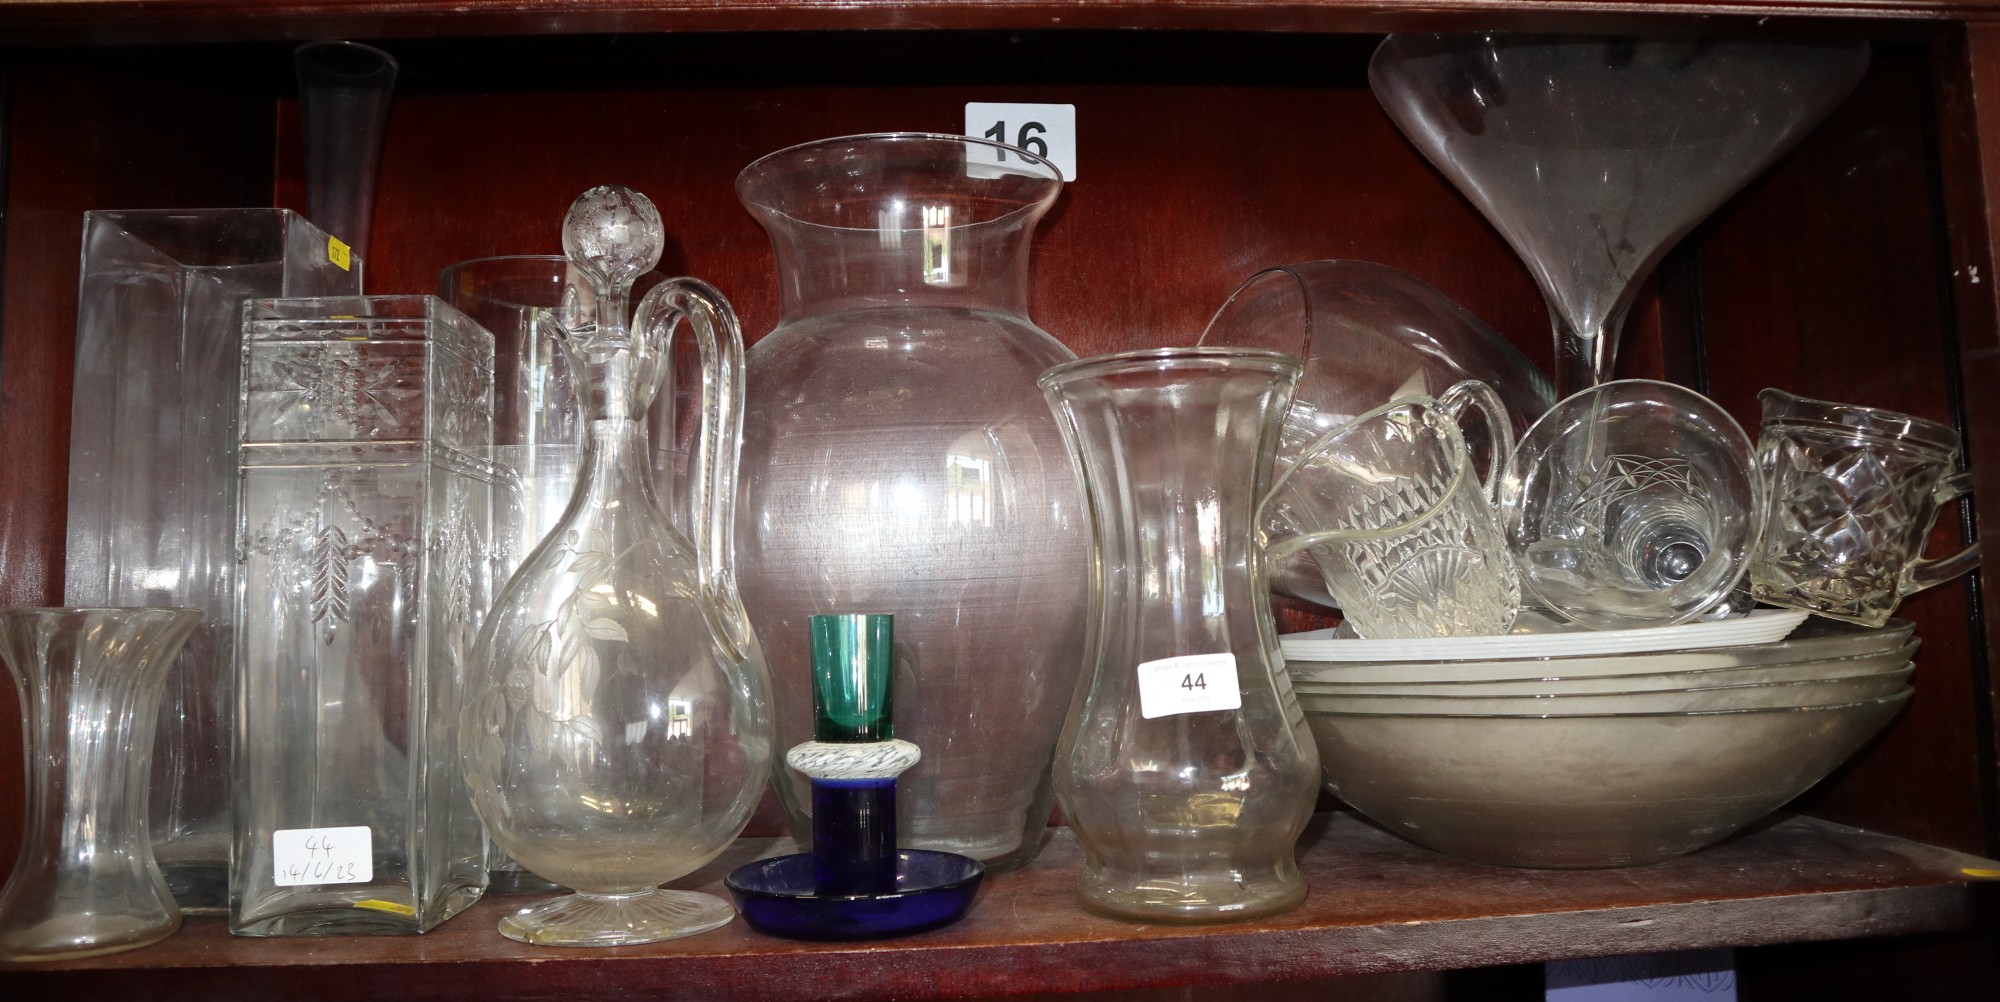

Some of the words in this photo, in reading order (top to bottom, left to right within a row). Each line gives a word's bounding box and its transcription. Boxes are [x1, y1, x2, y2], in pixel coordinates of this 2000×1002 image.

[985, 121, 1047, 165] 16
[1153, 664, 1173, 673] Jones
[1174, 662, 1180, 670] &
[1203, 659, 1228, 667] Limited
[1181, 672, 1207, 691] 44
[305, 835, 335, 858] 44
